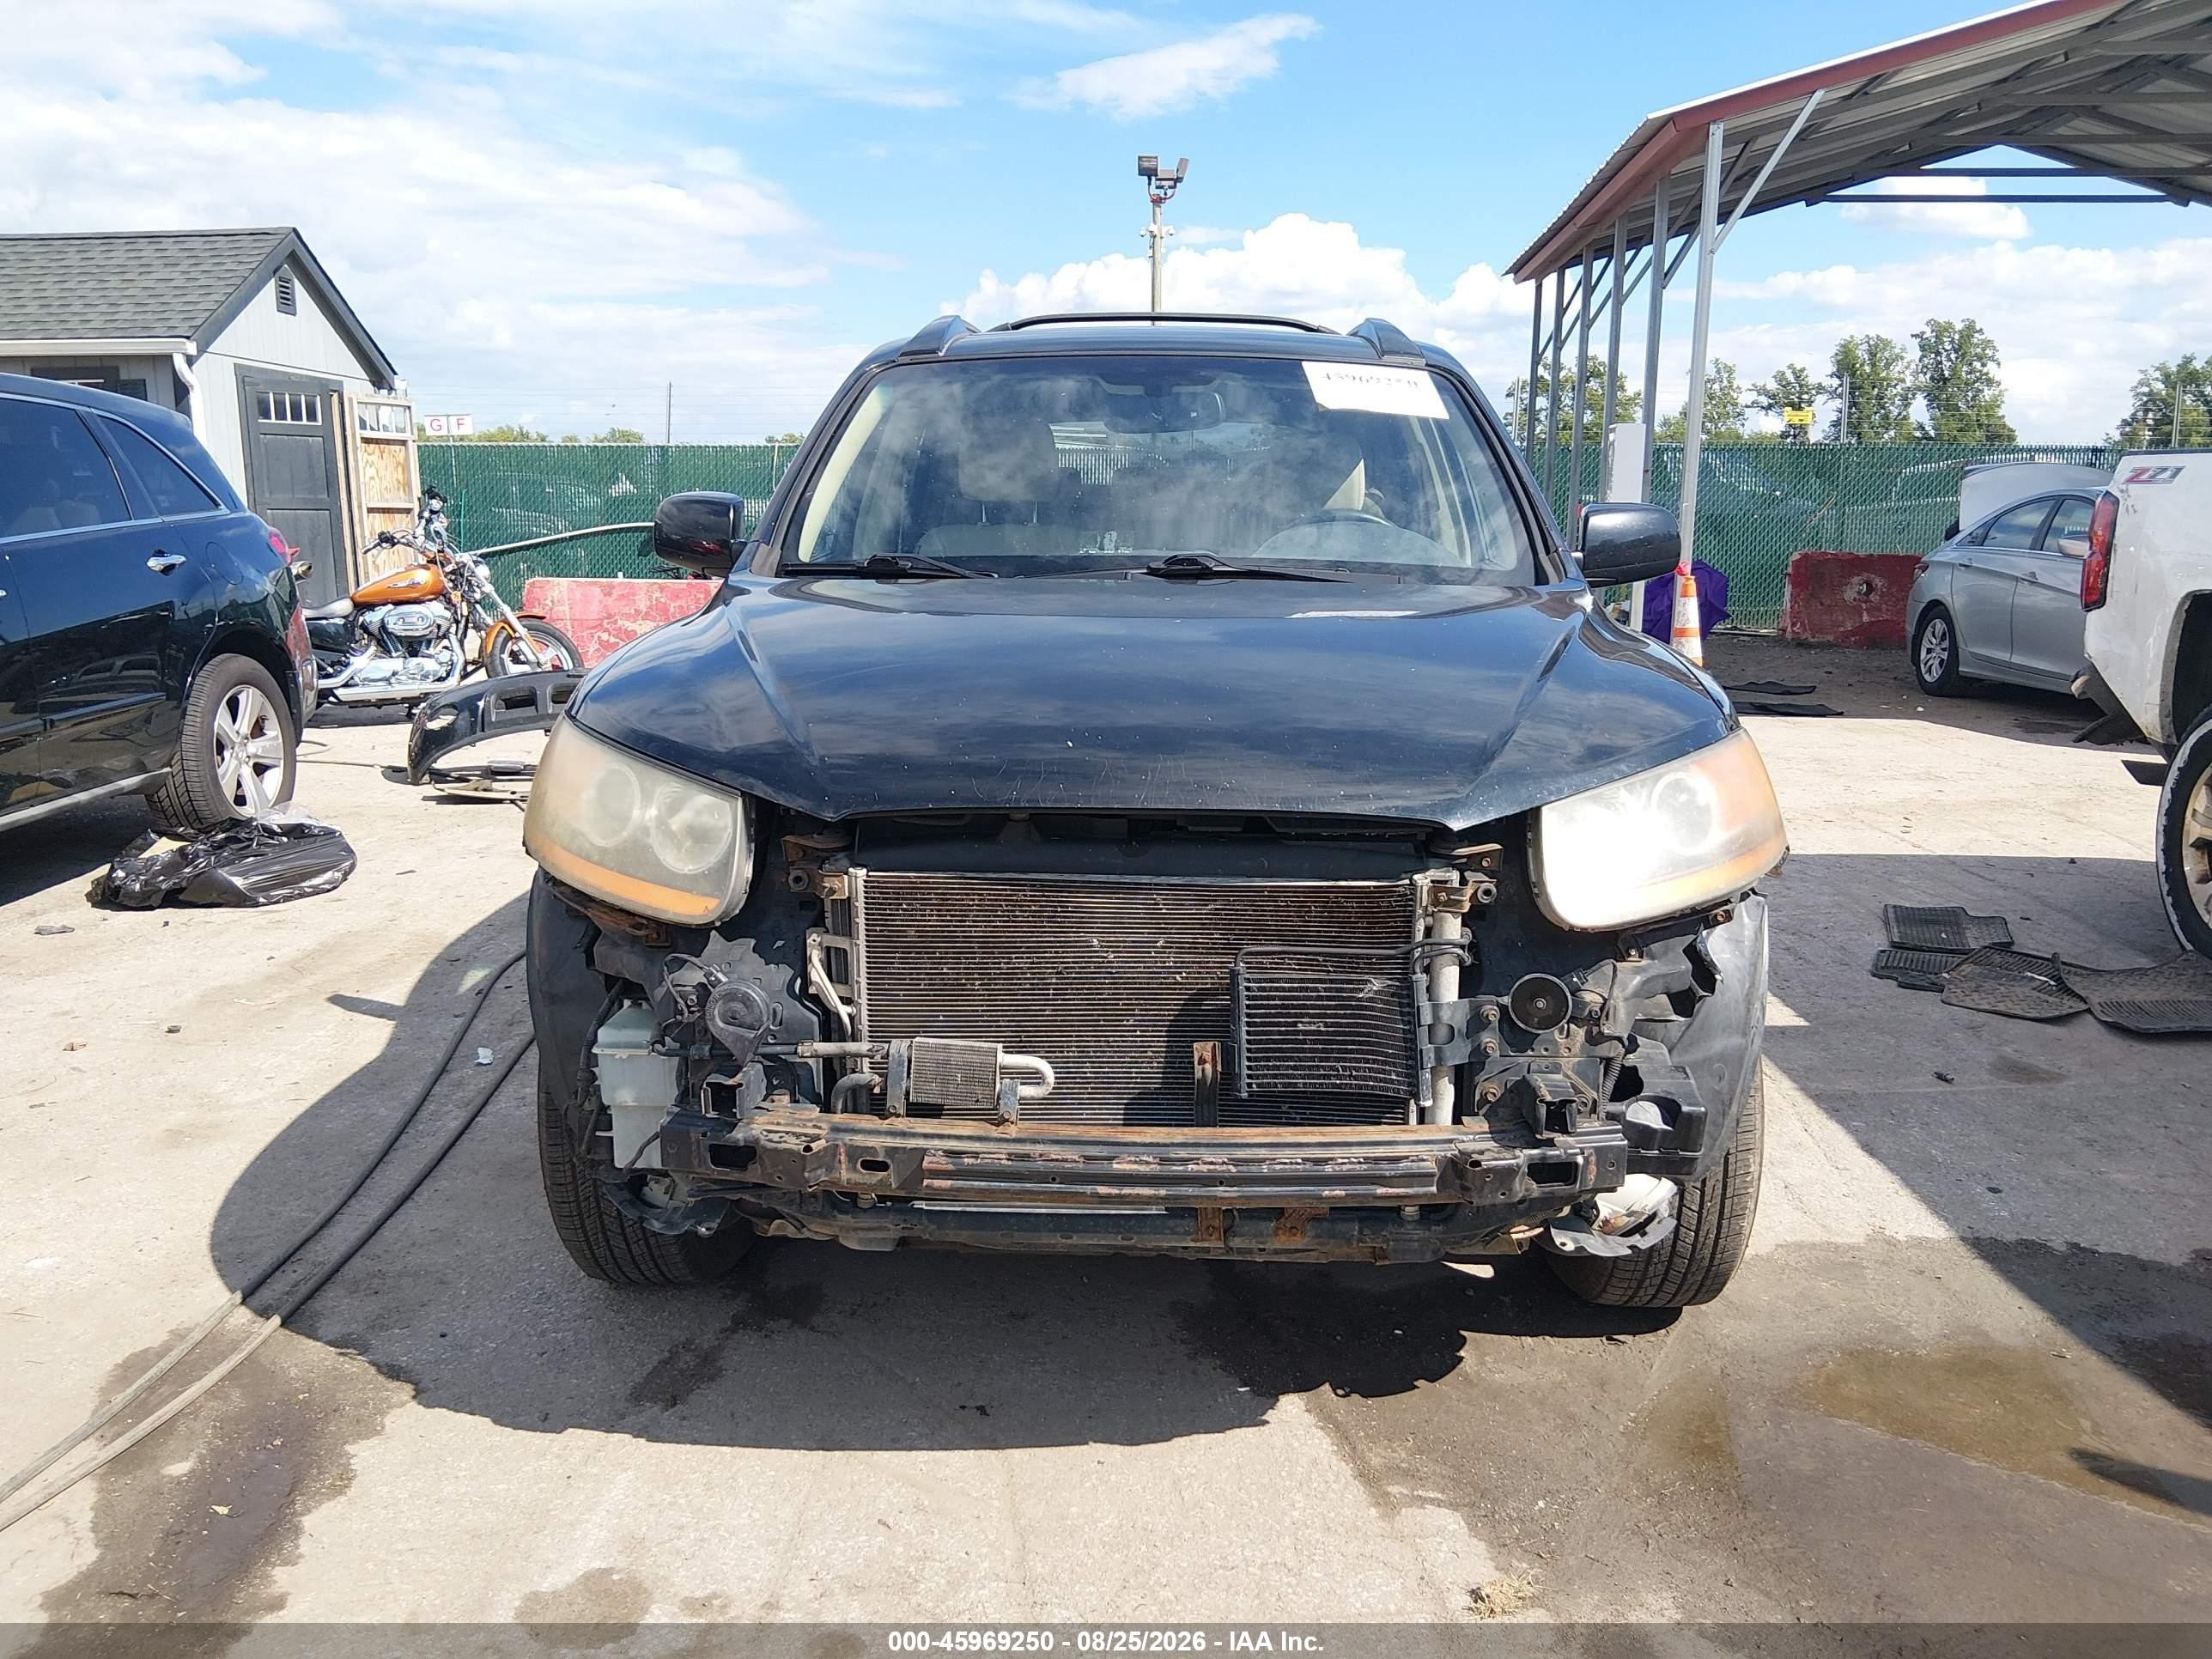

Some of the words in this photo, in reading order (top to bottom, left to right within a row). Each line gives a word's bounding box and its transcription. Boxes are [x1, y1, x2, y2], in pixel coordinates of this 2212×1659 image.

[430, 418, 442, 431] G
[457, 418, 465, 431] F
[2122, 465, 2187, 485] Z71
